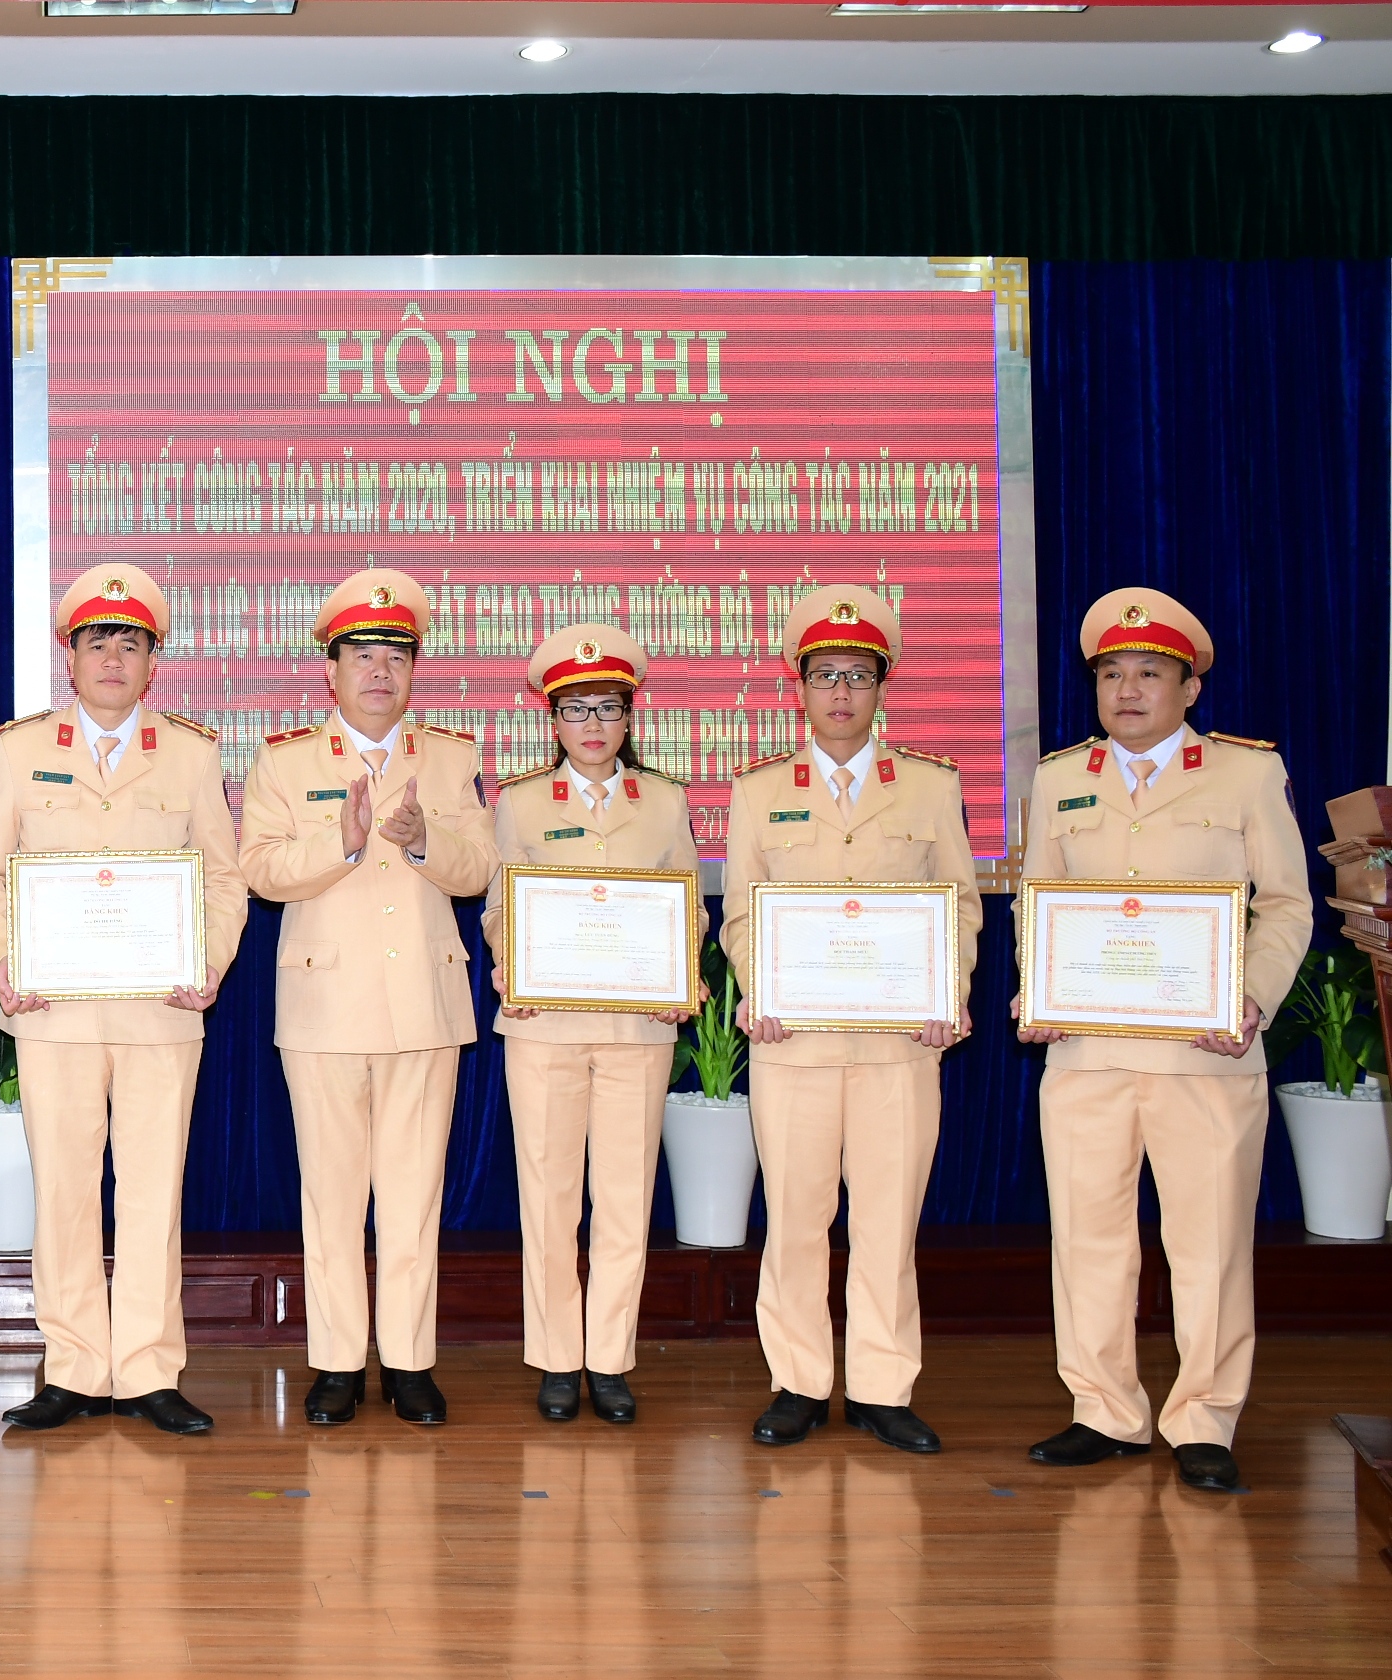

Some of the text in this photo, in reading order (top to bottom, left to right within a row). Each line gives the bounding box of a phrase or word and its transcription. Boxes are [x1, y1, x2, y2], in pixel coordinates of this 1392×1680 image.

[318, 302, 729, 428] HỘI NGHỊ
[67, 430, 980, 550] TỔNG KẾT CÔNG TÁC NĂM 2020, TRIỂN KHAI NHIỆM VỤ CÔNG TÁC NĂM 2021
[162, 555, 194, 657] ỦA
[203, 577, 248, 674] LỰC
[475, 584, 533, 657] GIAO
[628, 564, 712, 657] ĐƯỜNG
[630, 692, 691, 781] HÀNH
